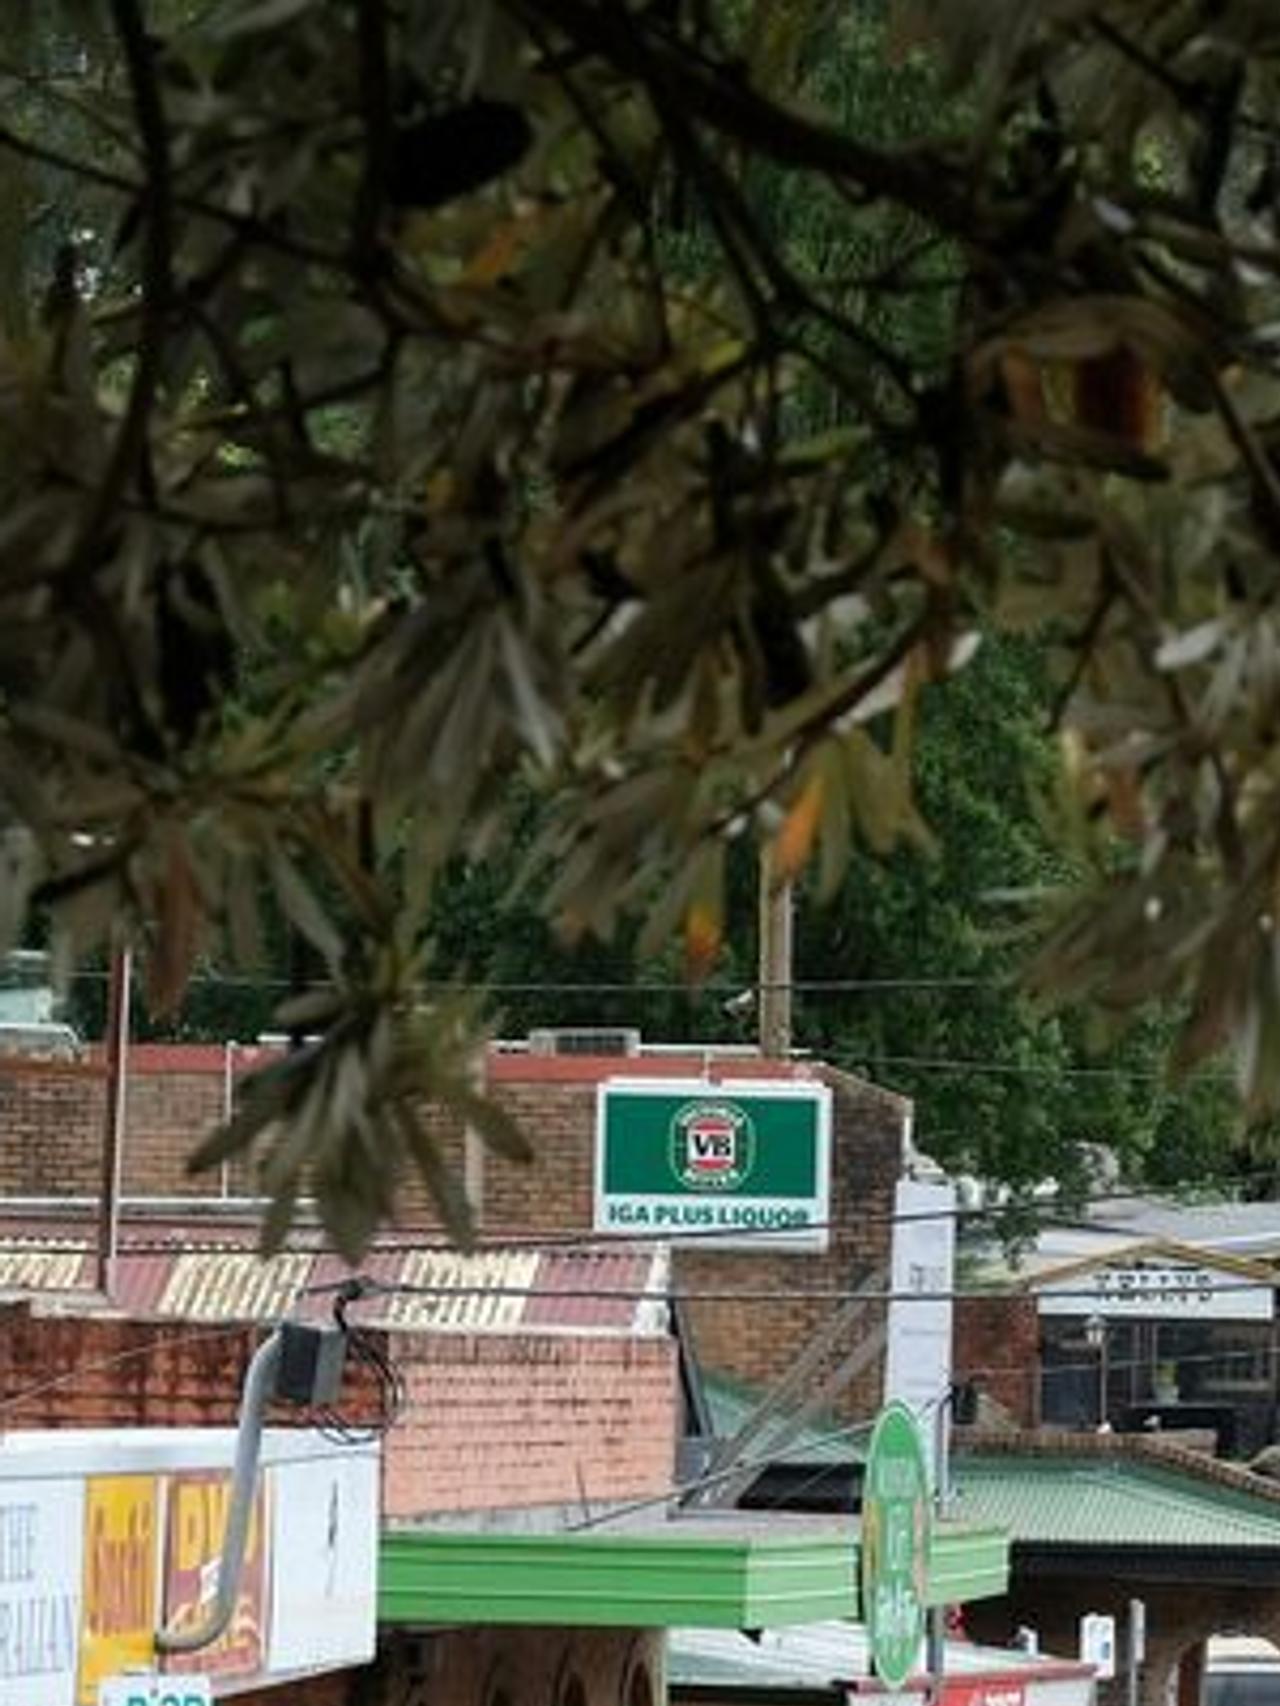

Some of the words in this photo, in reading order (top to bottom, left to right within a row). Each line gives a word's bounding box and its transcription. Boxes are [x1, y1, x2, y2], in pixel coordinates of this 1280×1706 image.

[692, 1133, 731, 1157] VB
[608, 1204, 649, 1224] IGA
[654, 1206, 713, 1226] PLUS
[718, 1207, 808, 1231] LIQUOR
